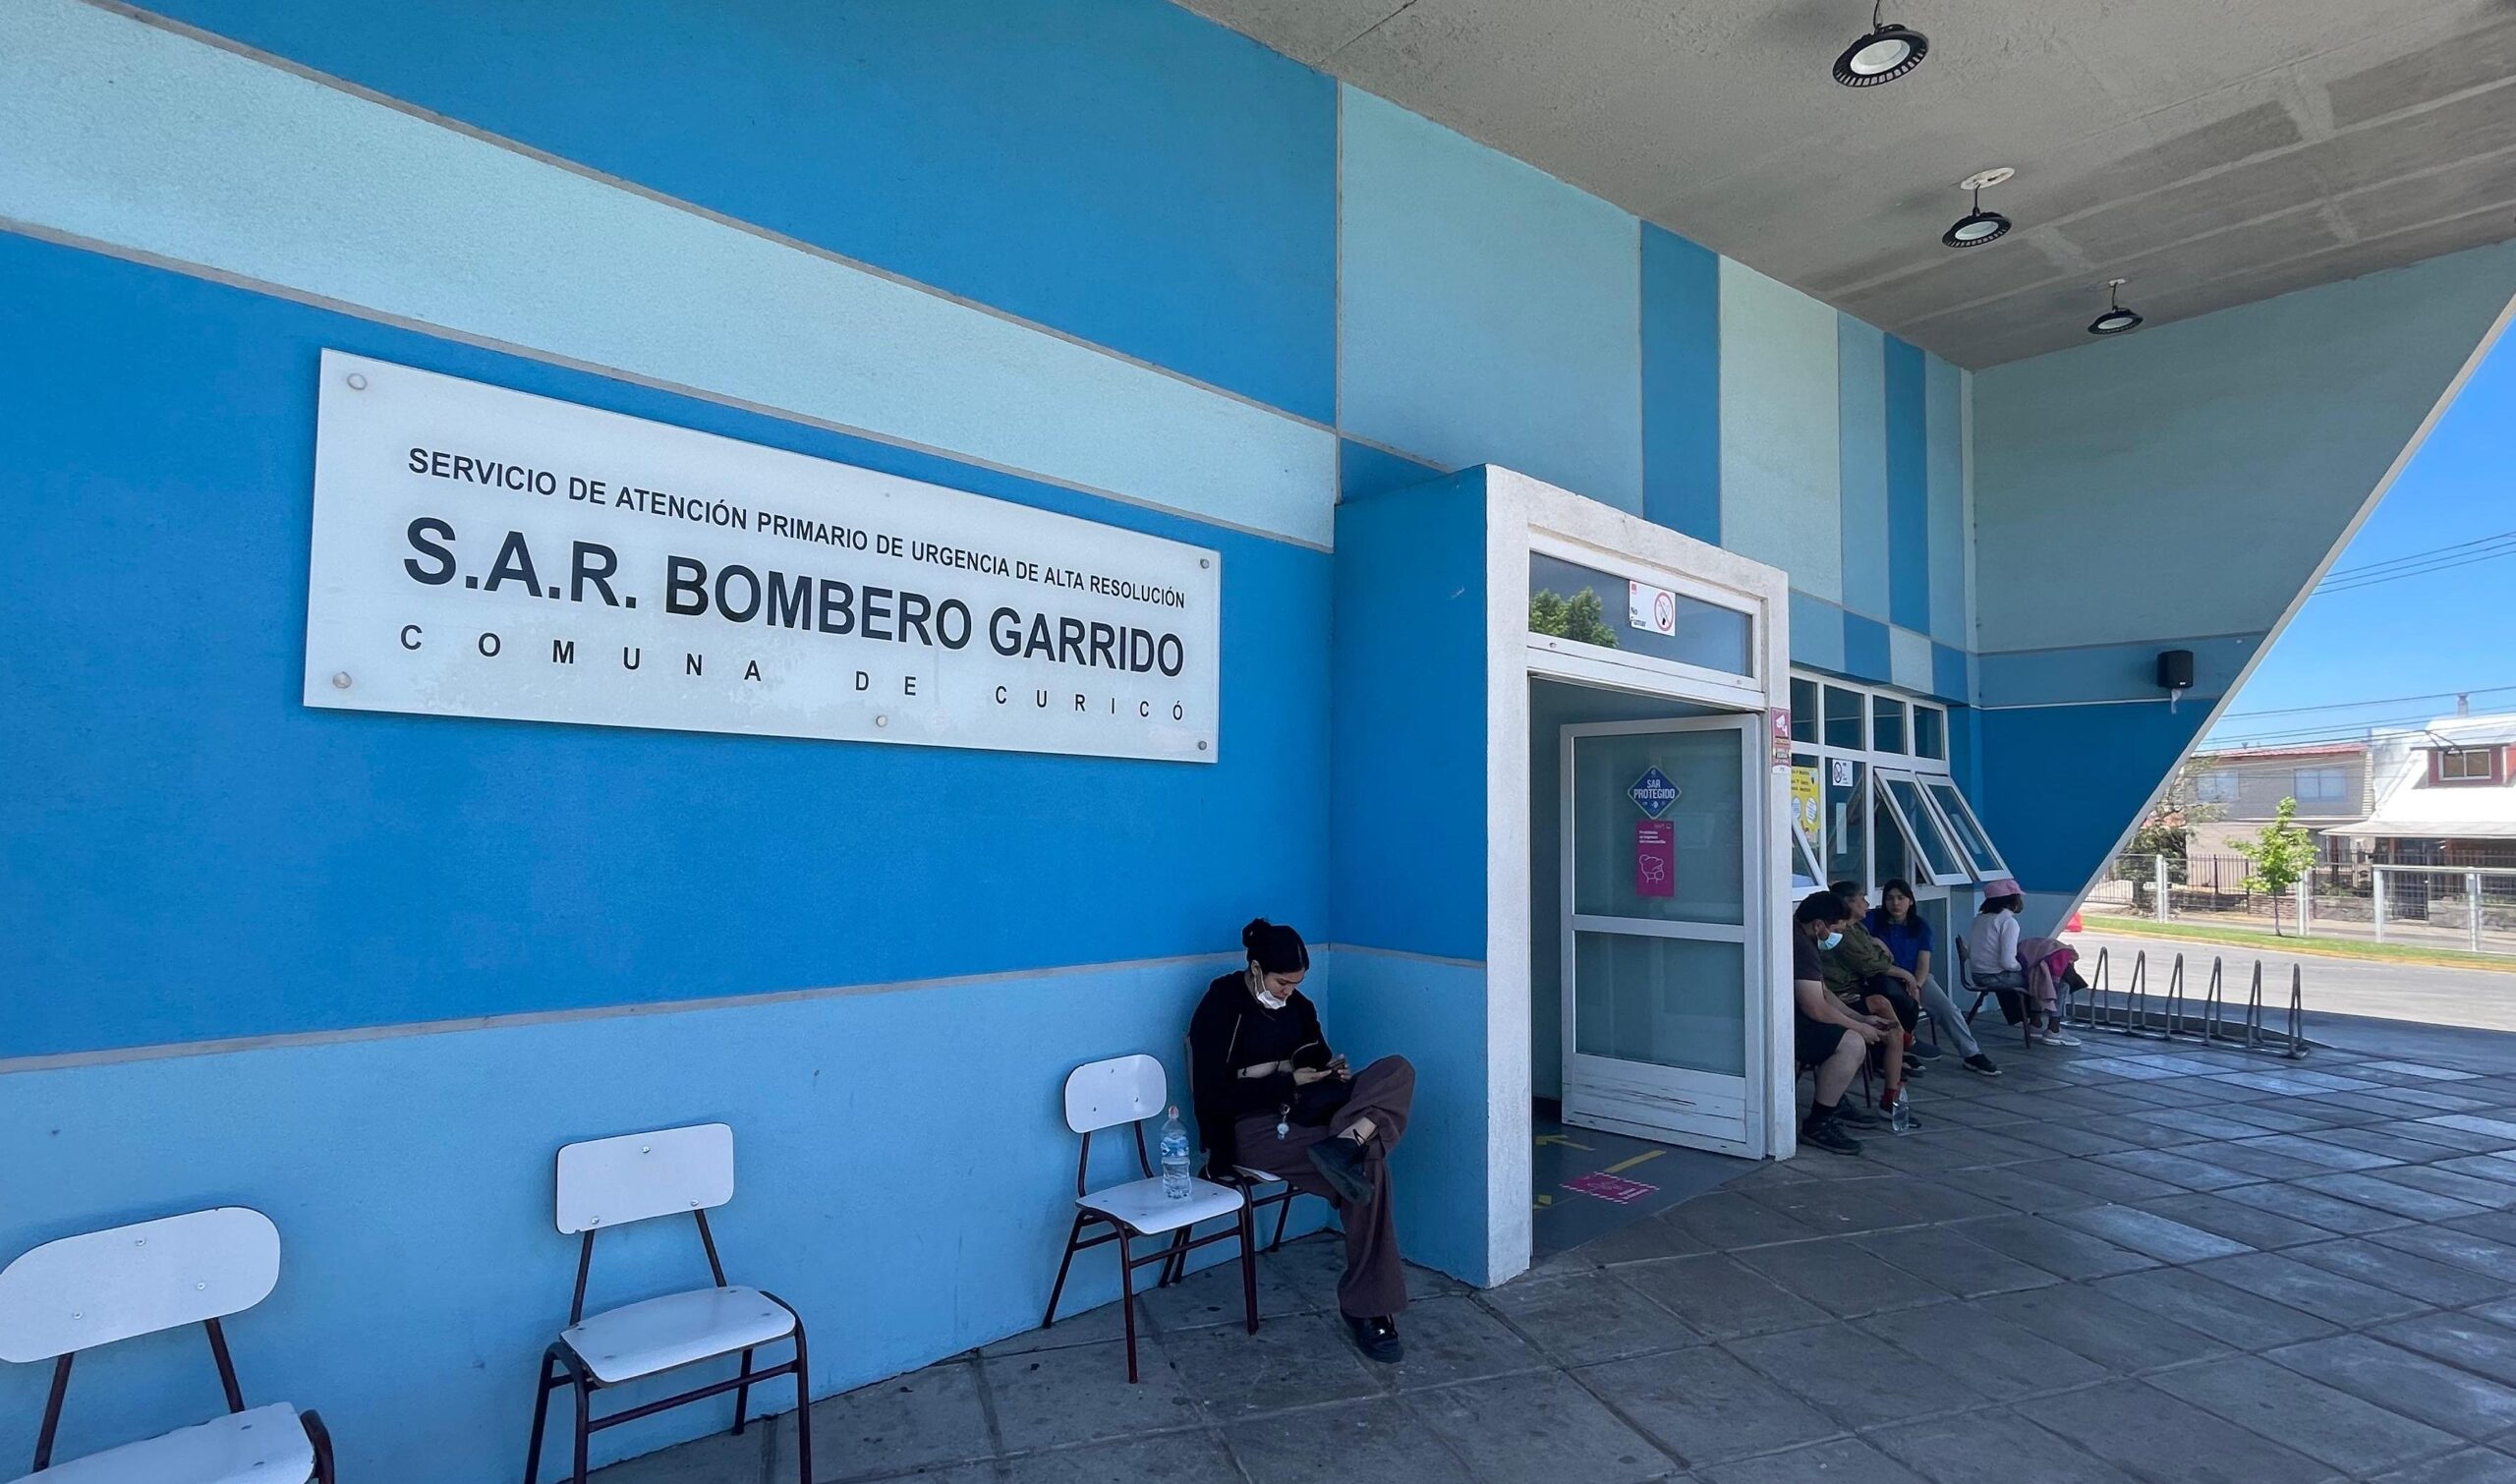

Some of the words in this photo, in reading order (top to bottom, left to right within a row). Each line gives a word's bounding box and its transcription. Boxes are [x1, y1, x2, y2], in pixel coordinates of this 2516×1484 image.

[408, 447, 556, 495] SERVICIO
[568, 477, 606, 505] DE
[614, 486, 747, 530] ATENCIÓN
[757, 511, 868, 550] PRIMARIO
[876, 534, 903, 558] DE
[912, 541, 1010, 577] URGENCIA
[1015, 561, 1039, 583] DE
[1044, 566, 1085, 591] ALTA
[1090, 575, 1184, 608] RESOLUCIÓN
[403, 517, 637, 609] S.A.R.
[665, 554, 972, 650] BOMBERO
[989, 606, 1184, 677] GARRIDO
[400, 624, 762, 682] COMUNA
[855, 670, 917, 697] DE
[995, 685, 1183, 721] CURICÓ
[1633, 788, 1676, 799] PROTEGIDO
[1646, 778, 1661, 789] SAR
